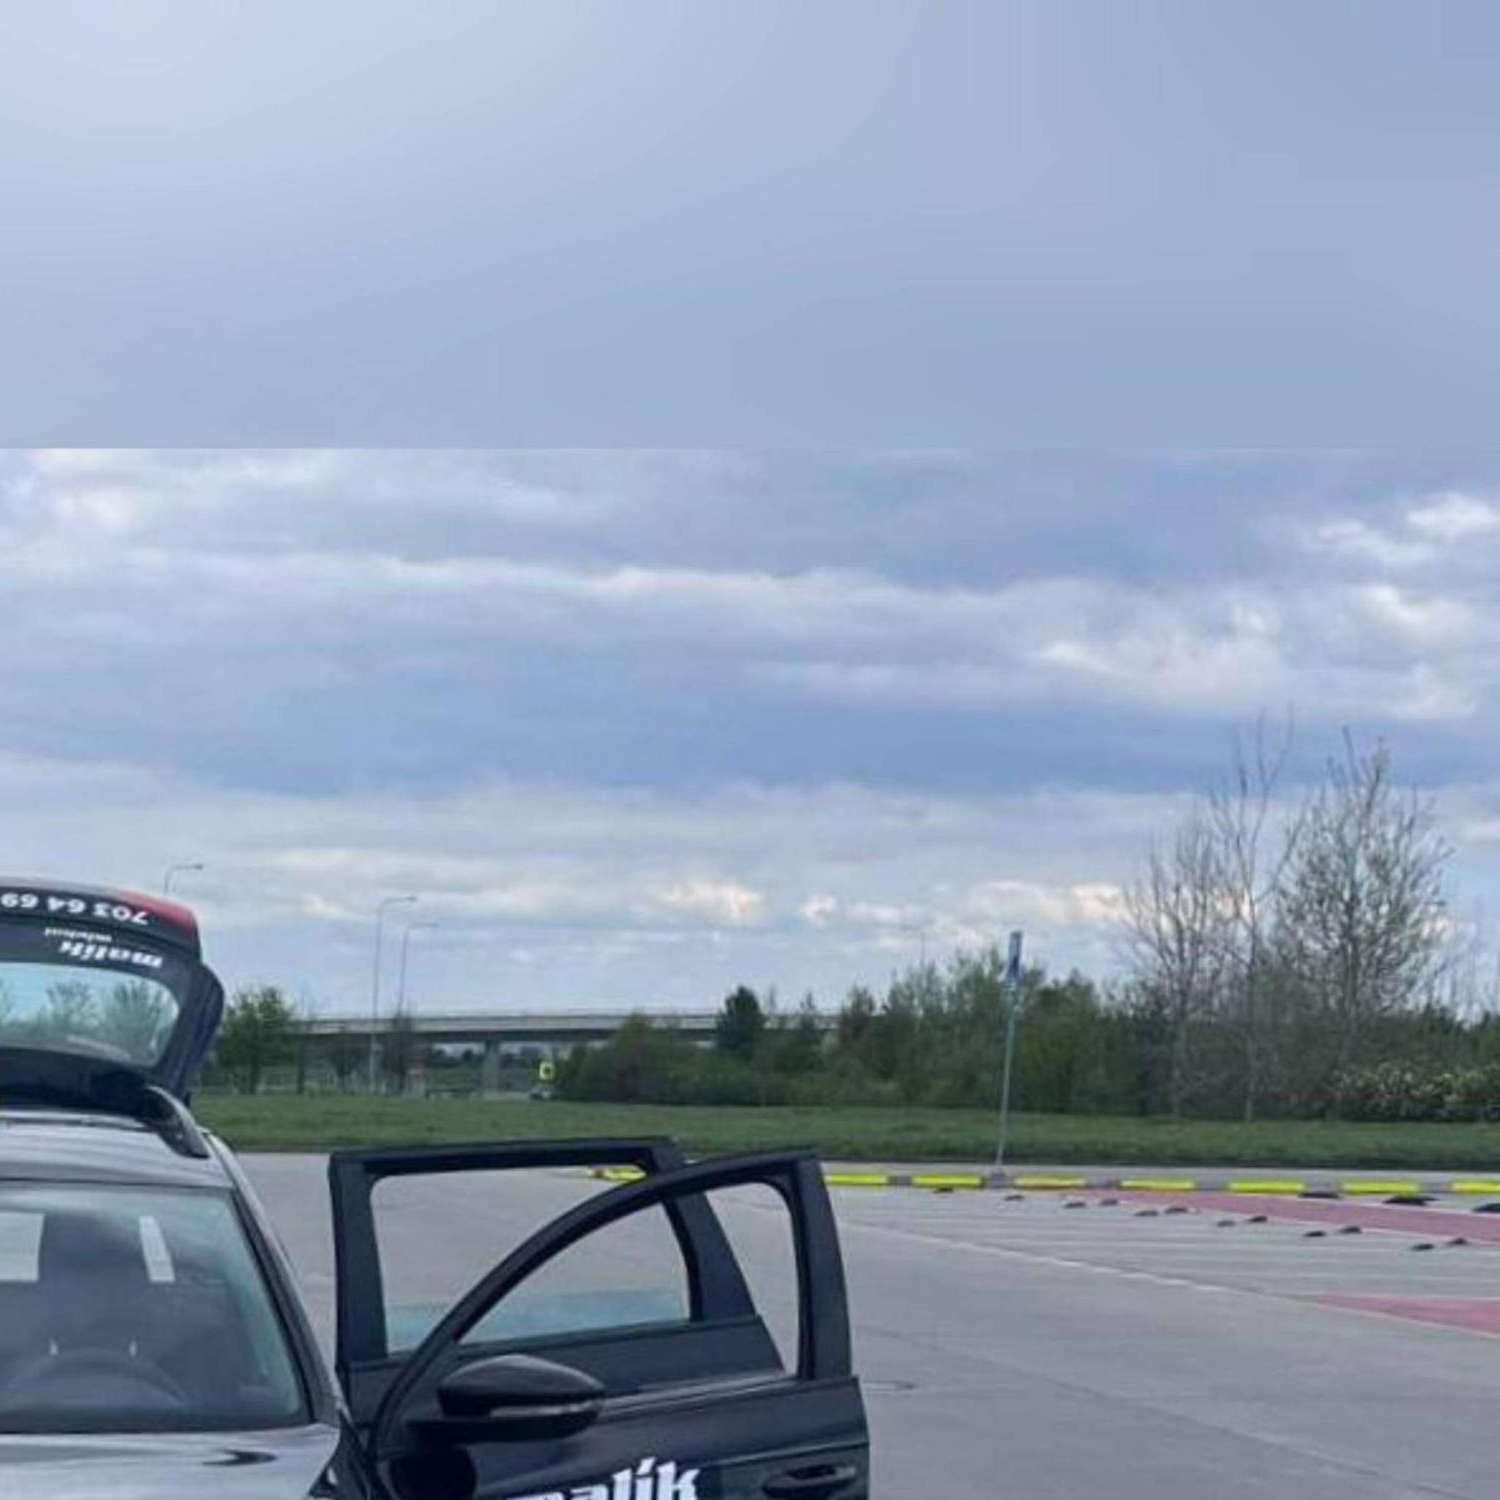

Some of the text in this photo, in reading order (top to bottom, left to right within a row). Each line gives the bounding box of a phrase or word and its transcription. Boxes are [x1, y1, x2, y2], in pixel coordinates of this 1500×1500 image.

[0, 892, 39, 909] 69
[47, 896, 87, 914] 64
[92, 902, 149, 926] 703
